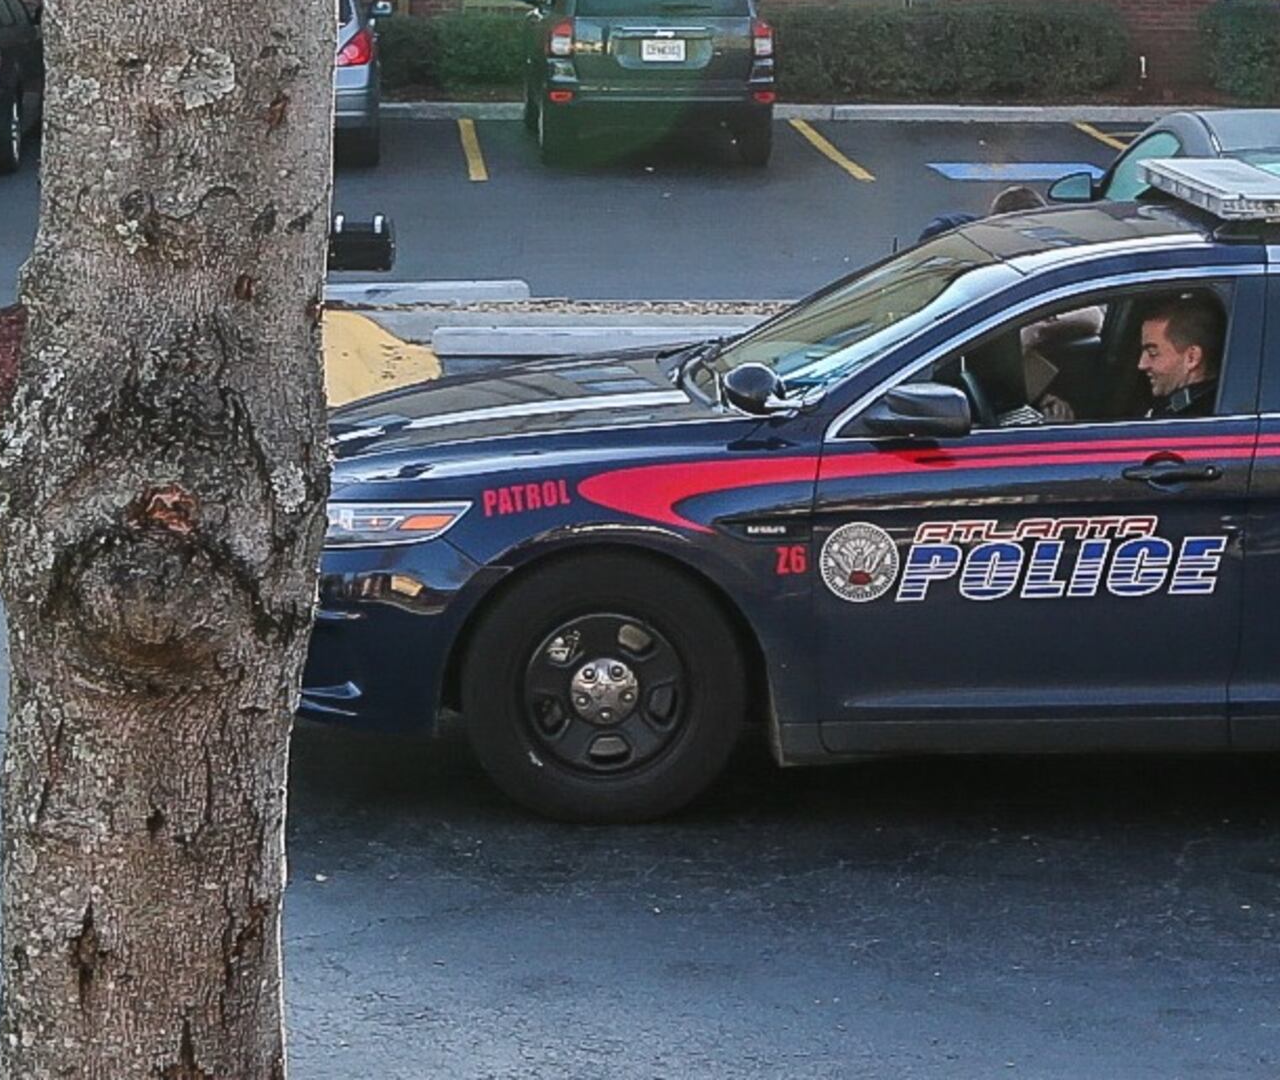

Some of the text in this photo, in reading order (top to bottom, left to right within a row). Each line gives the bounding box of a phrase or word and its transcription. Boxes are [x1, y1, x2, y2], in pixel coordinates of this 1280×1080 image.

[483, 479, 571, 517] PATROL
[913, 516, 1158, 543] ATLANTA
[775, 545, 807, 575] Z6
[895, 536, 1228, 602] POLICE
